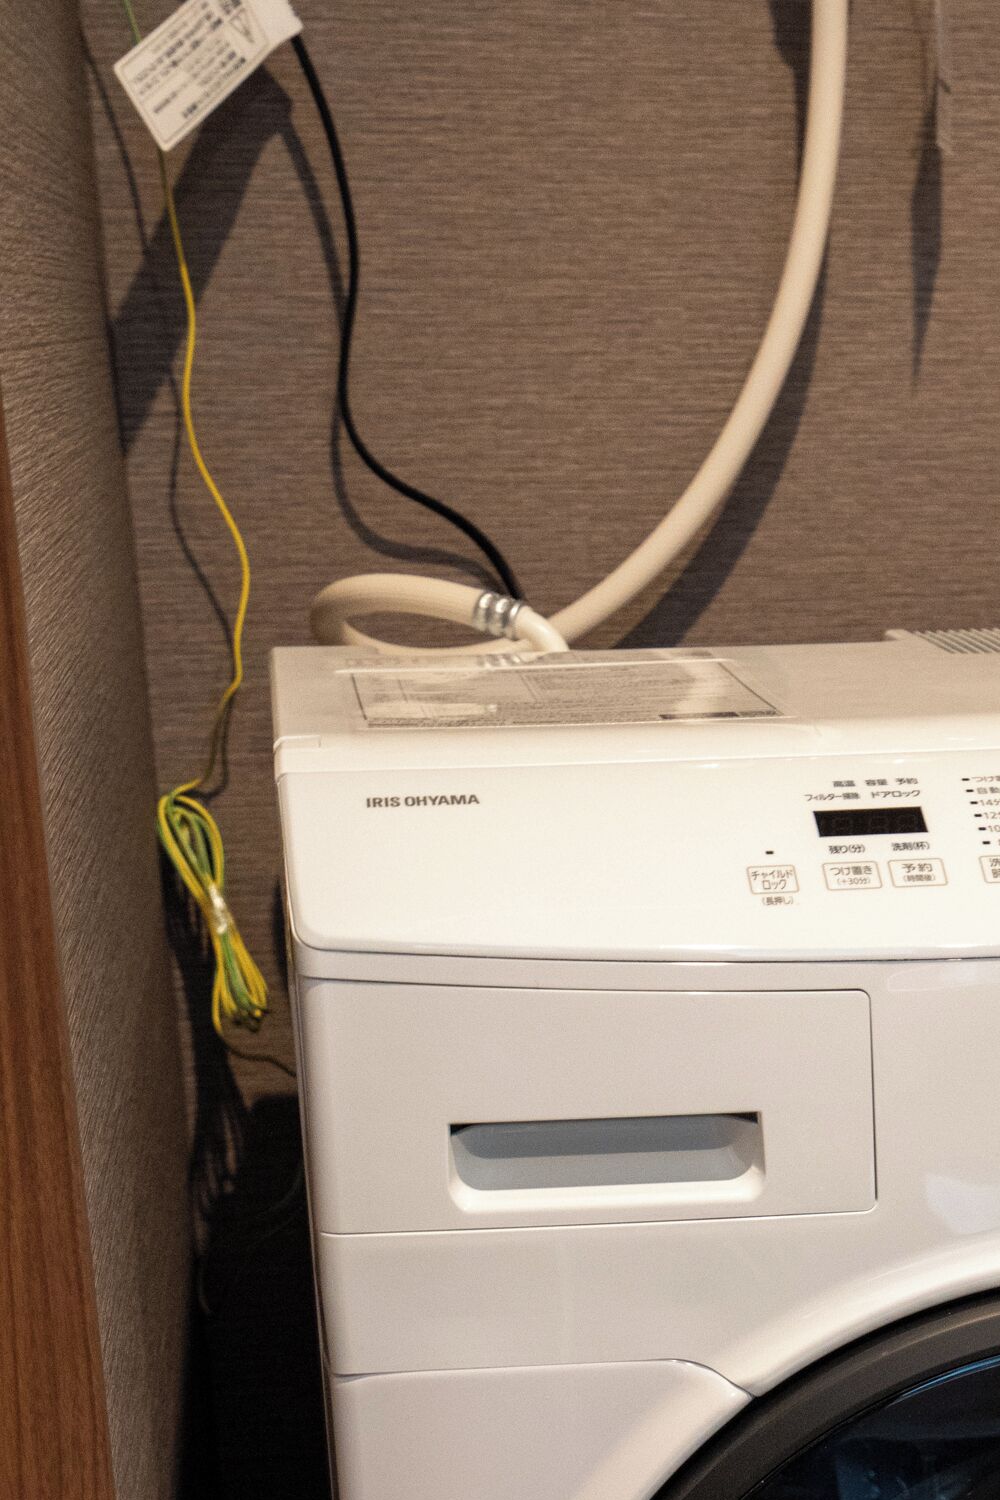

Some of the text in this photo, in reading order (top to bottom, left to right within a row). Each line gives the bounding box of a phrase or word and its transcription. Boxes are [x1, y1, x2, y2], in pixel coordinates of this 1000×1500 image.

[896, 777, 918, 785] 予約
[871, 790, 920, 798] ドアロック
[977, 786, 1000, 794] 自動
[366, 794, 480, 808] IRIS OHYAMA
[828, 841, 930, 854] 残り(分) 洗剤(杯)
[830, 866, 873, 876] つけ置き
[902, 863, 933, 873] 予約
[751, 870, 793, 880] チャイルド
[762, 880, 787, 890] ロック
